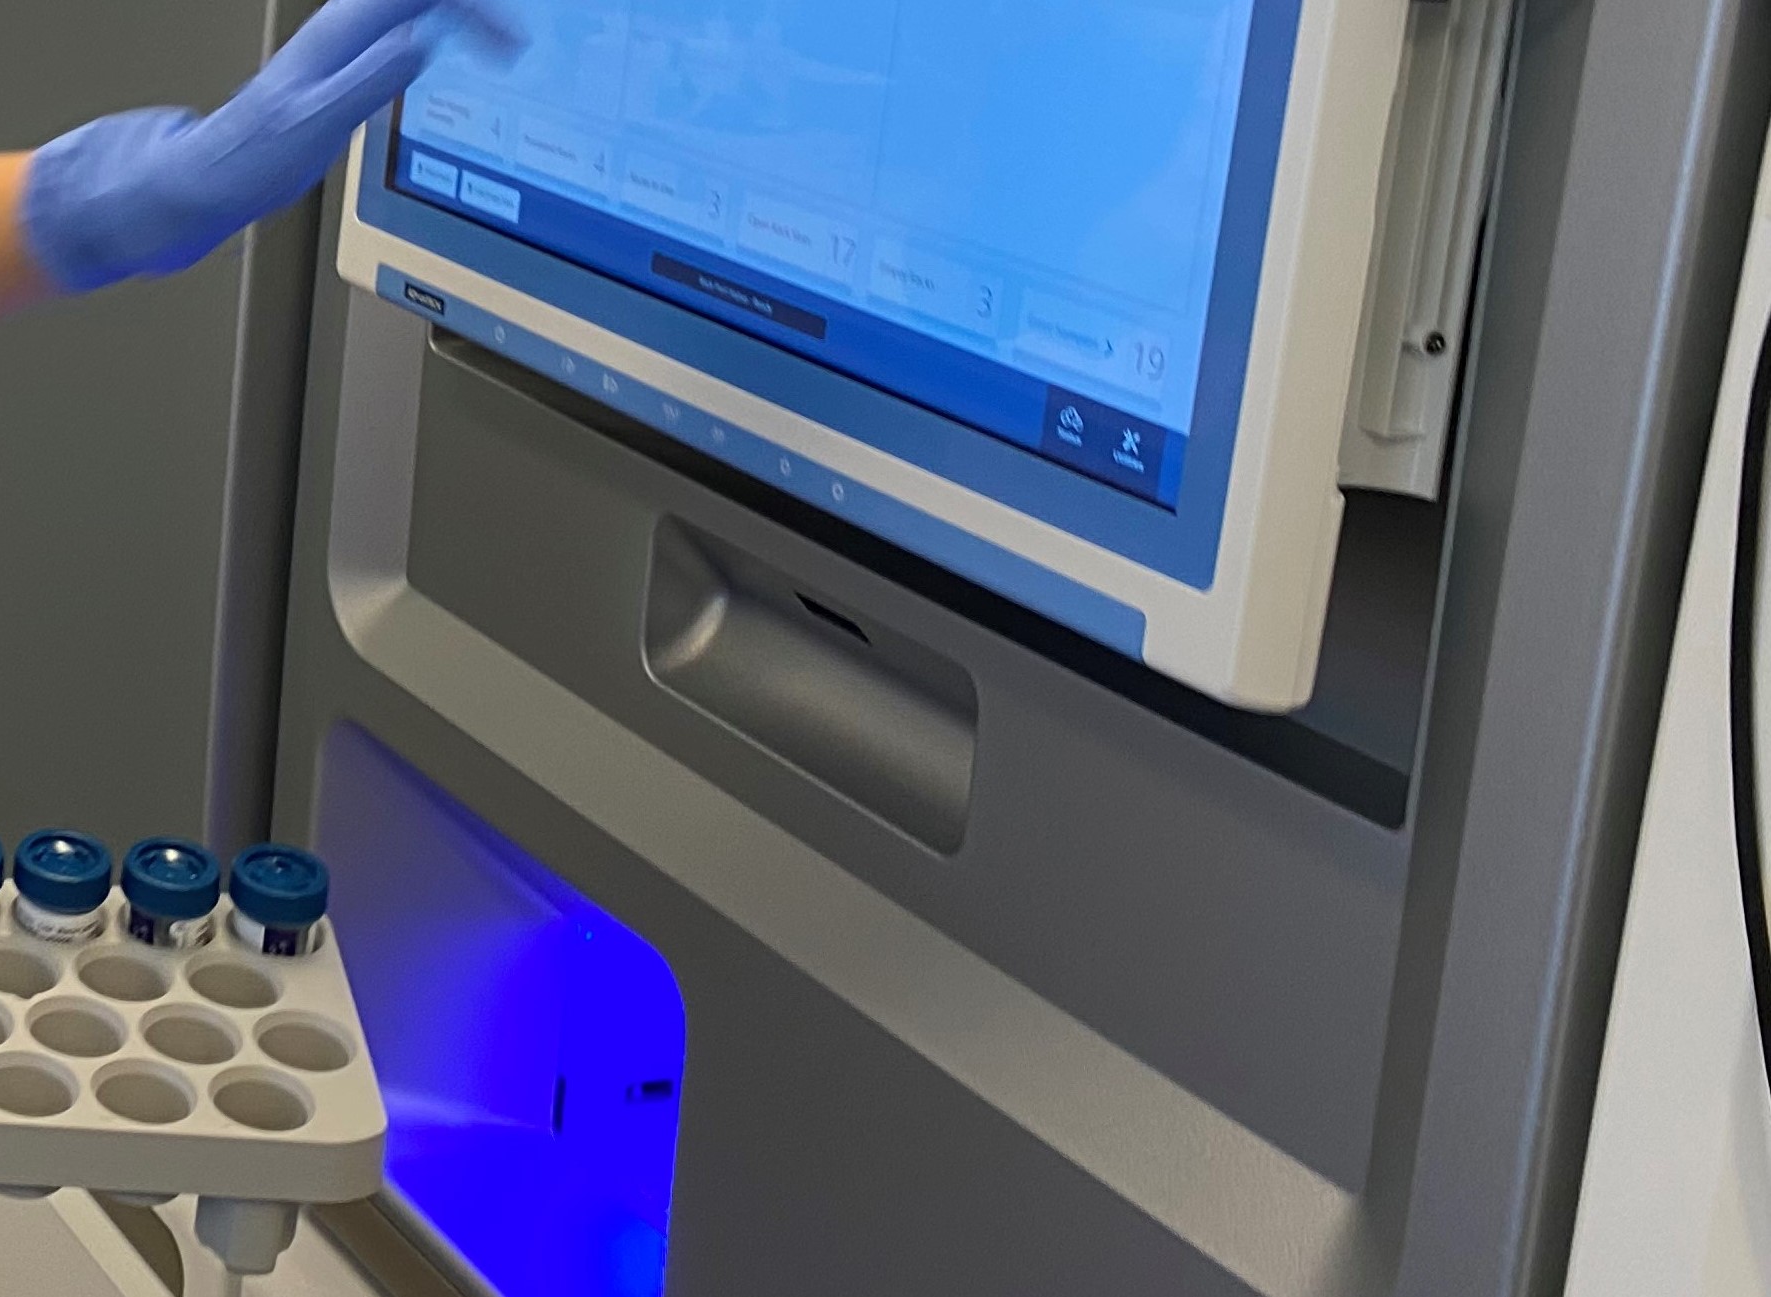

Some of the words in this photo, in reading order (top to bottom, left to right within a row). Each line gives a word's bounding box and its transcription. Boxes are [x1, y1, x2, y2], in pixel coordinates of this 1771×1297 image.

[830, 234, 857, 268] 17
[975, 284, 994, 319] 3
[1134, 340, 1166, 381] 19
